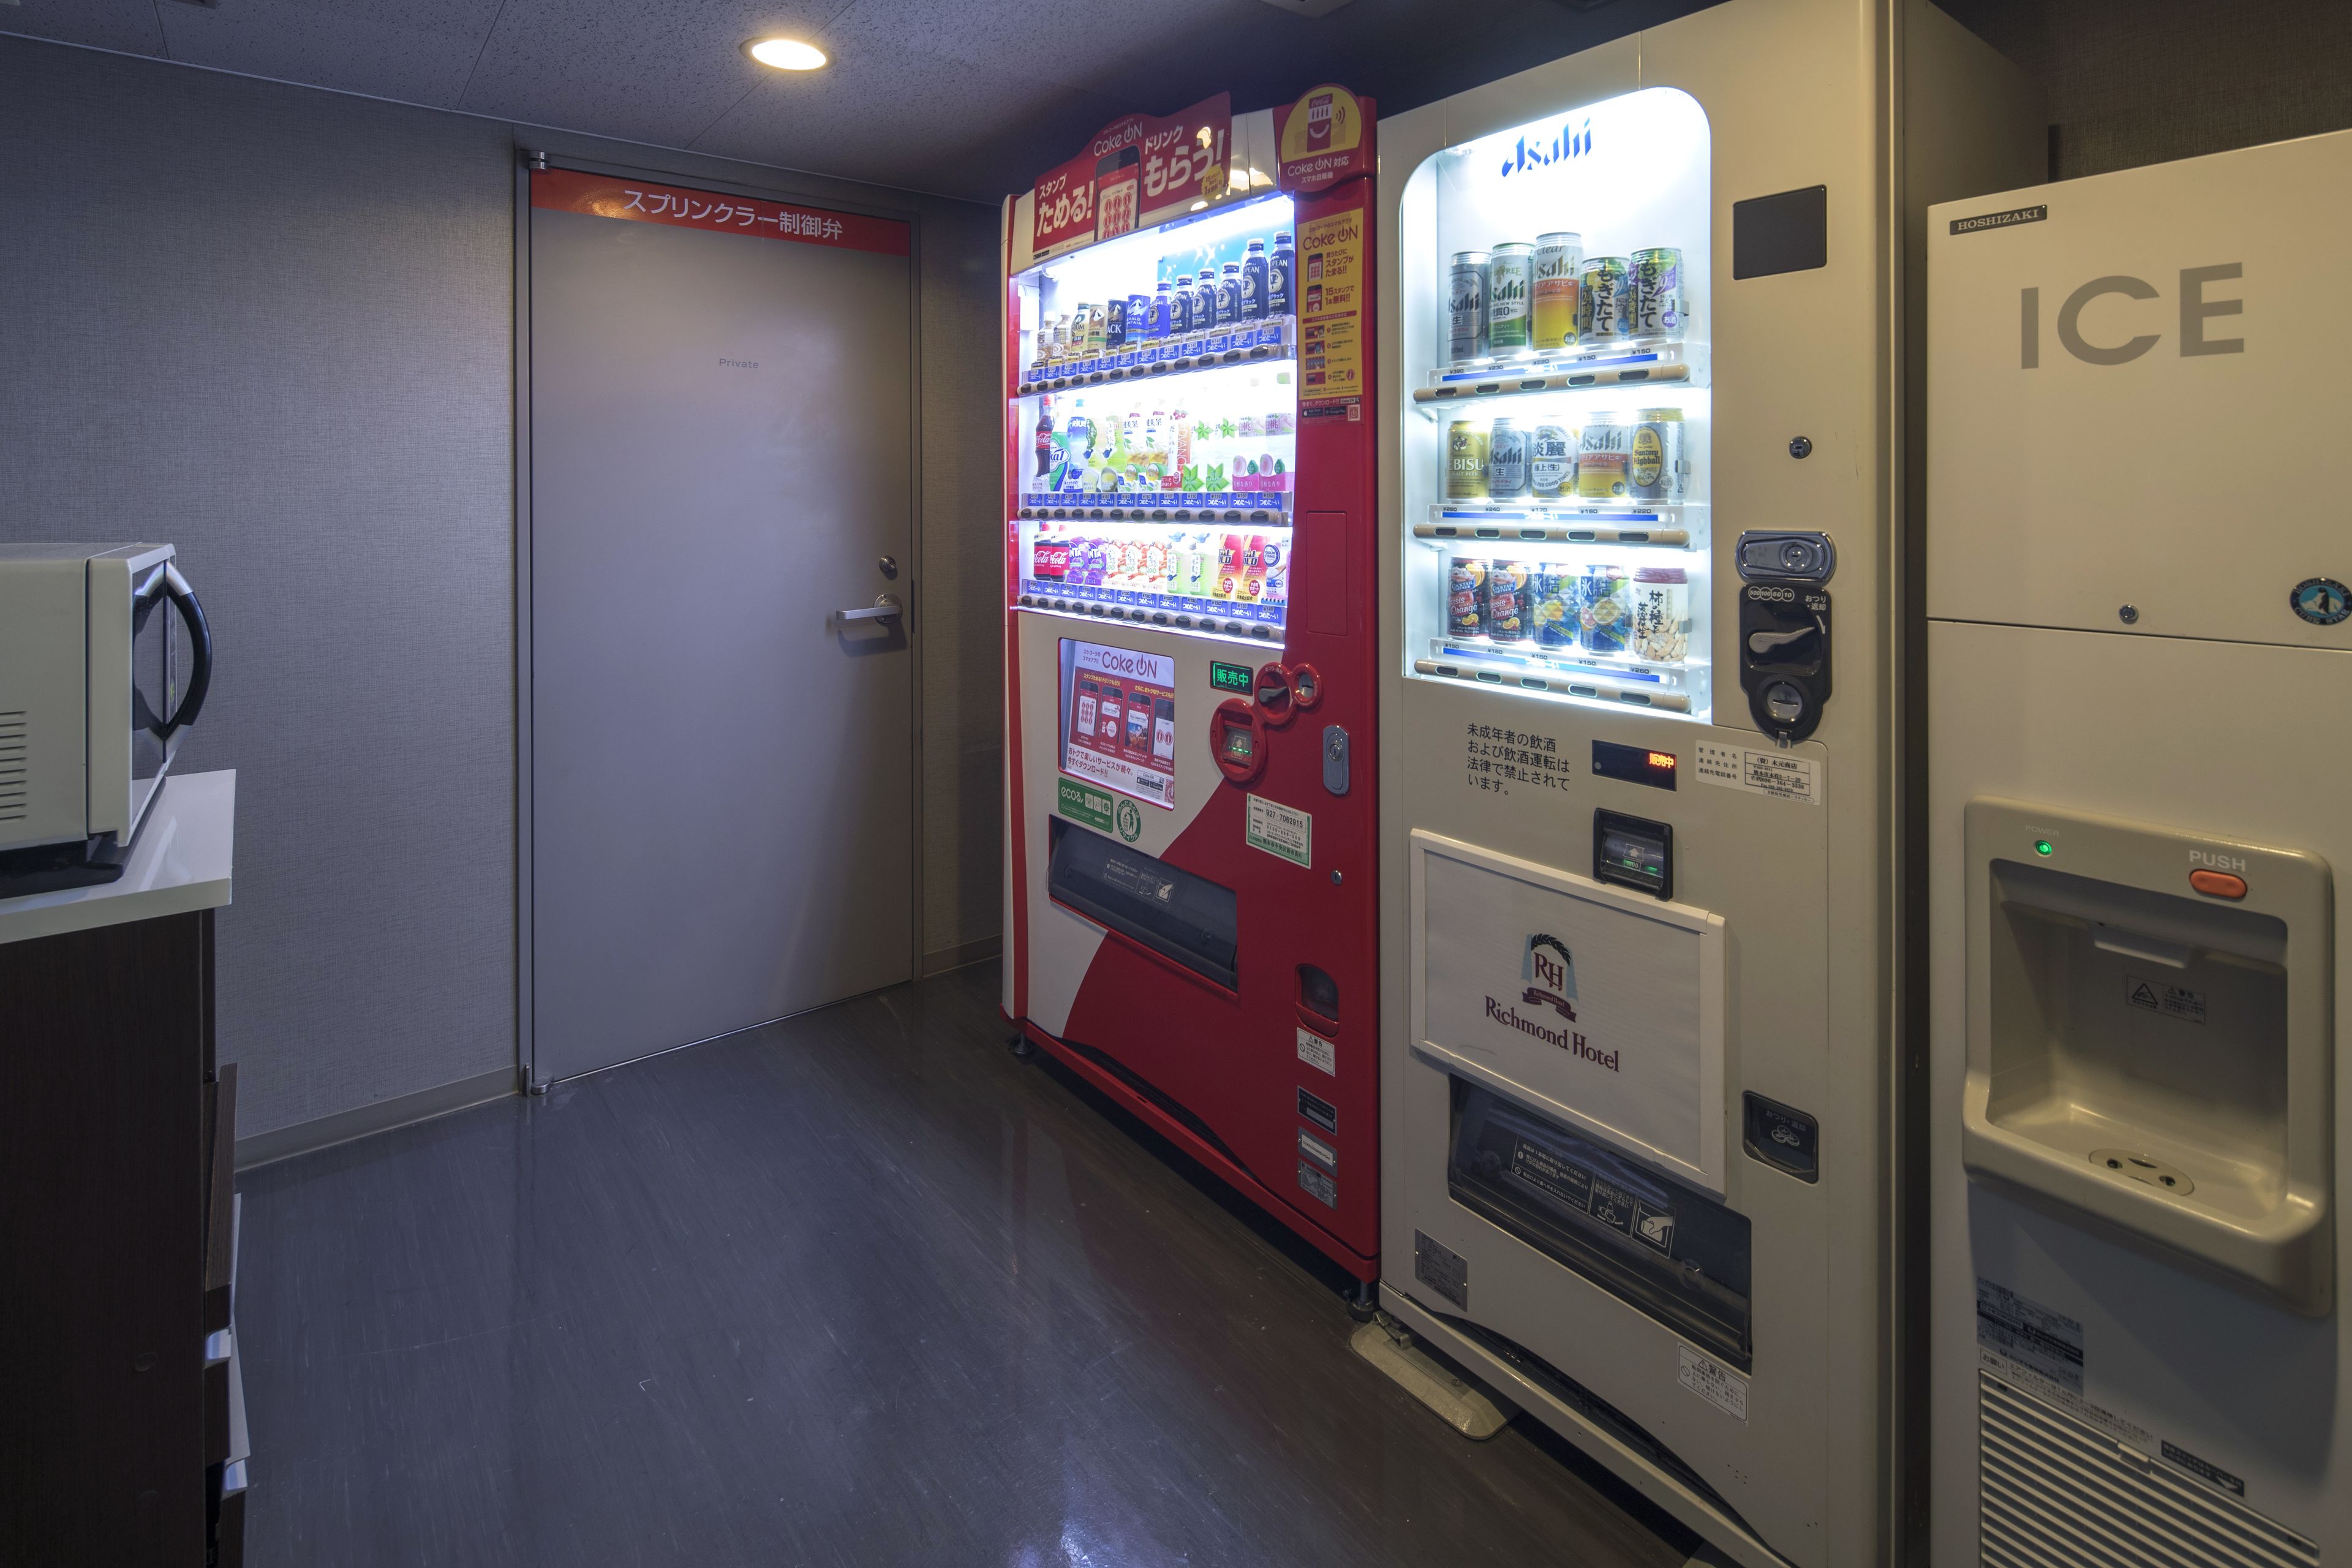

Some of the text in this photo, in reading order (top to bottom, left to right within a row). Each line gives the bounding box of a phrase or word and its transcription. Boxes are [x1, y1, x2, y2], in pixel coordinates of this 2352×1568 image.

[1094, 122, 1142, 157] Coke ON
[1145, 125, 1183, 154] ドリンク
[1501, 117, 1591, 177] Asahi
[1287, 156, 1349, 176] Coke ON 対応
[1039, 173, 1068, 200] スタンプ
[1302, 171, 1333, 184] スマホ自販機
[624, 189, 843, 241] スプリンクラー制御弁
[1957, 208, 2039, 231] HOSHIZAKI
[1303, 225, 1358, 251] Coke ON
[1325, 255, 1354, 268] スタンプが
[1326, 249, 1348, 258] 買うたびに
[1597, 268, 1614, 332] もぎたて
[1640, 260, 1656, 328] もぎたて
[1452, 315, 1462, 325] 生
[1663, 315, 1677, 325] お酒
[2021, 262, 2244, 370] ICE
[718, 358, 759, 369] Private
[1633, 455, 1660, 466] Highball
[1495, 468, 1506, 477] 生
[1534, 573, 1560, 595] 氷結
[1581, 578, 1612, 597] 氷結
[1102, 651, 1157, 679] Coke ON
[1217, 668, 1249, 687] 販売中
[1467, 723, 1556, 753] 未成年者の飲酒
[1068, 747, 1133, 776] おトクで楽しいサービスが続々。
[1468, 740, 1570, 774] および飲酒運転は
[1649, 753, 1674, 769] 販売中
[1698, 747, 1737, 759] 管理者名
[1698, 757, 1737, 769] 連絡先住所
[1467, 756, 1570, 791] 法律で禁止されて
[1698, 767, 1737, 780] 連絡先電話番号
[1468, 774, 1509, 796] います。
[1265, 809, 1303, 828] 927 7062915
[1119, 826, 1138, 842] リサイクル
[2025, 824, 2060, 837] POWER
[2189, 850, 2246, 872] PUSH
[1533, 952, 1564, 992] RH
[1533, 989, 1565, 1007] Richmond Hotel
[1485, 995, 1620, 1073] Richmond Hotel
[1982, 1352, 2005, 1370] お願い
[1708, 1364, 1726, 1382] 警告
